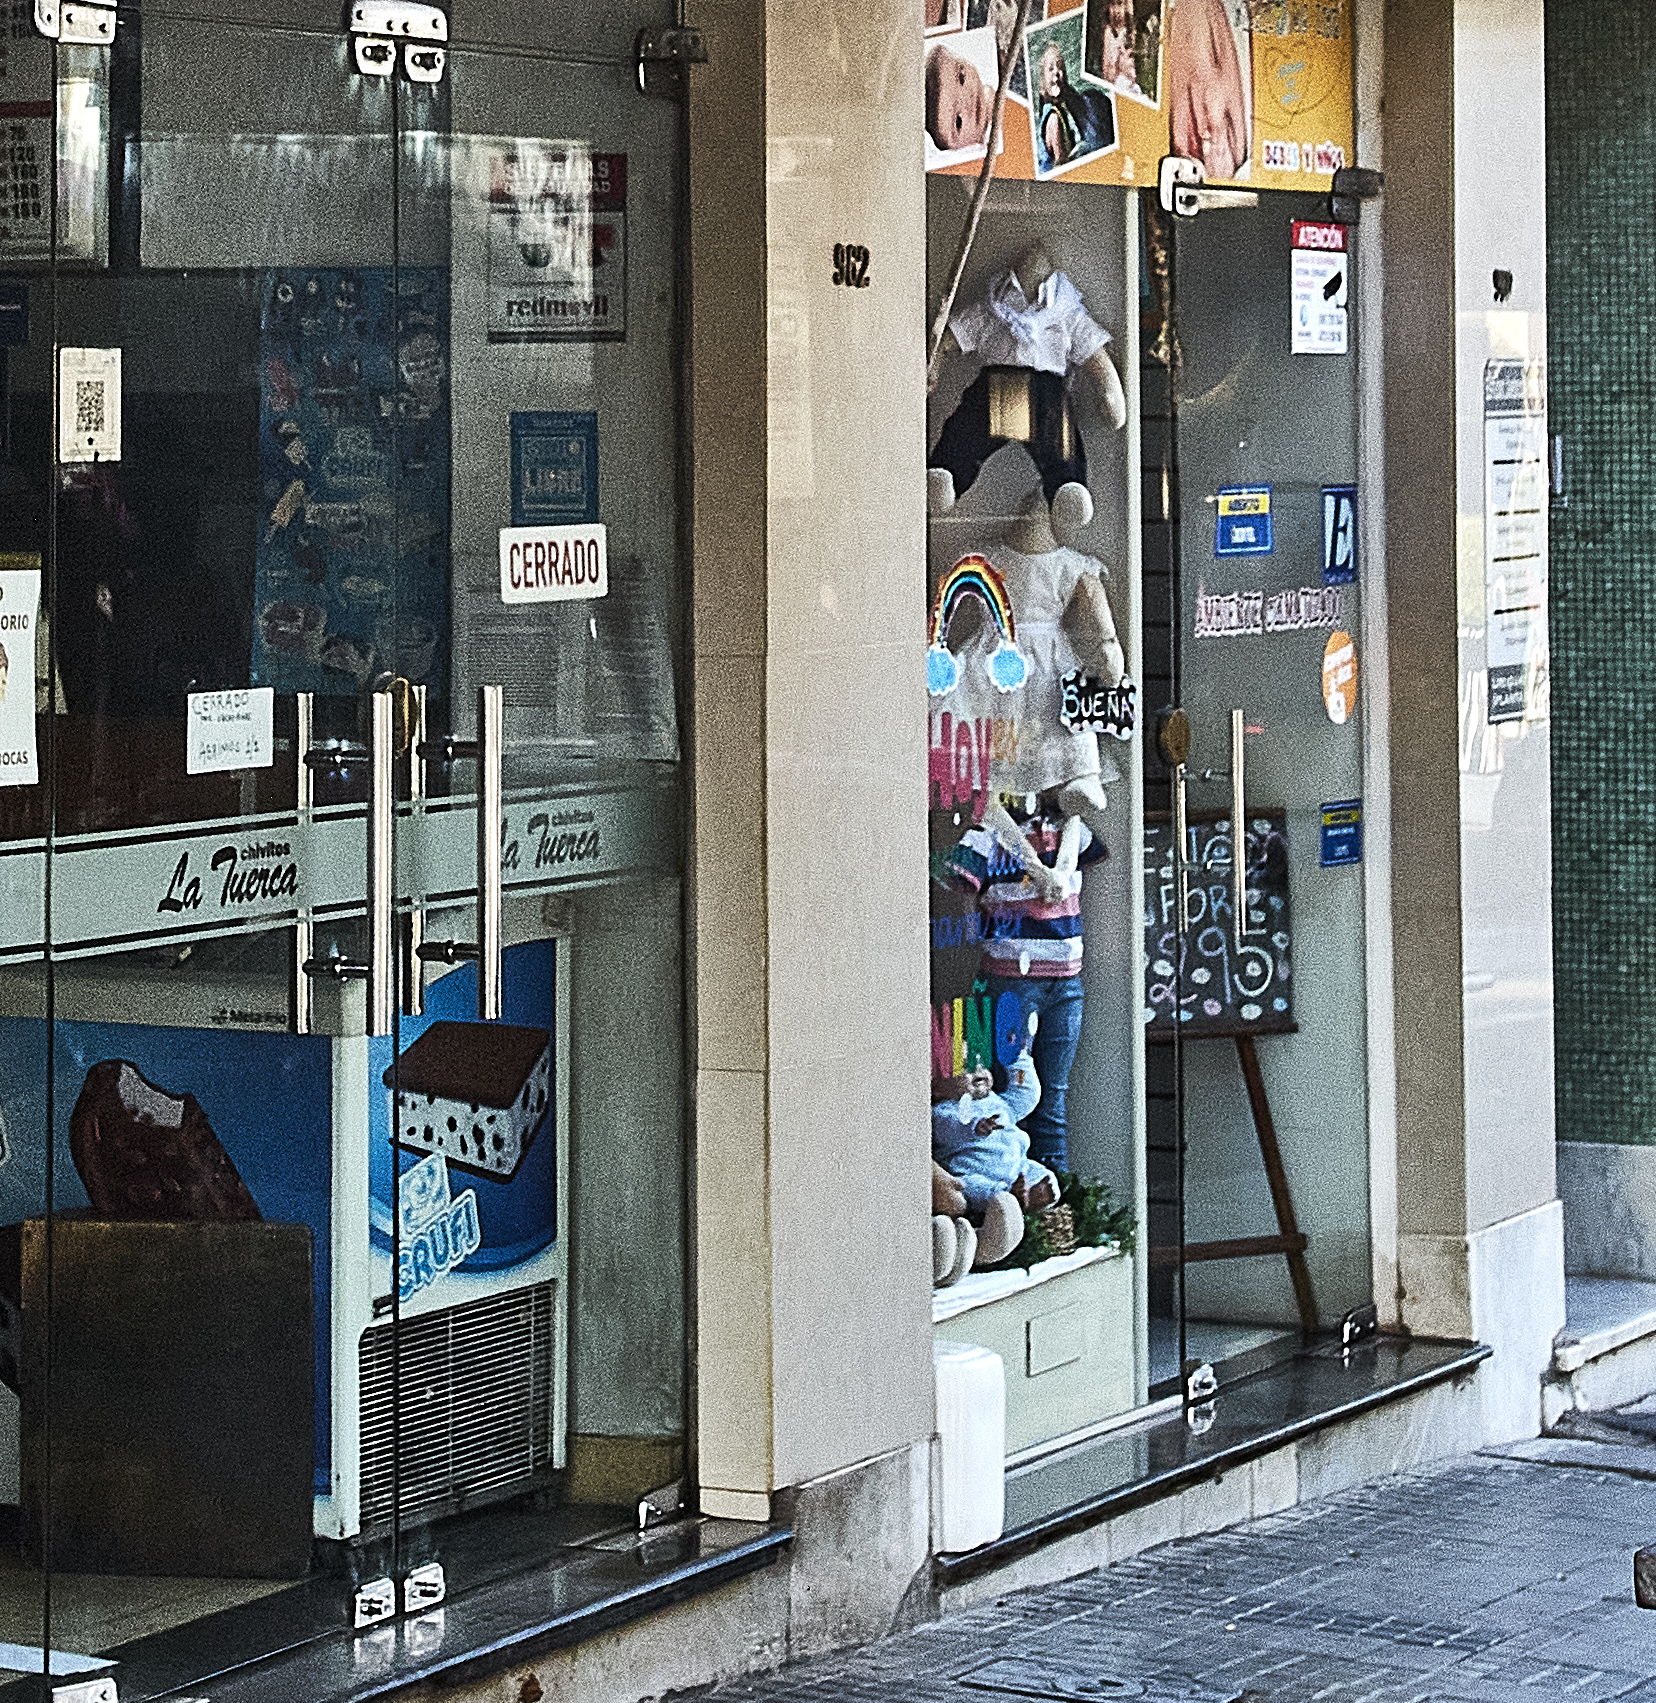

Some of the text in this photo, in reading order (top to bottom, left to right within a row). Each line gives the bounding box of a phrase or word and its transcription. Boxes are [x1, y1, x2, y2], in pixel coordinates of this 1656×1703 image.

[832, 243, 870, 288] 962
[509, 539, 600, 590] CERRADO
[240, 840, 292, 862] chivitos
[157, 846, 300, 915] La Tuerca
